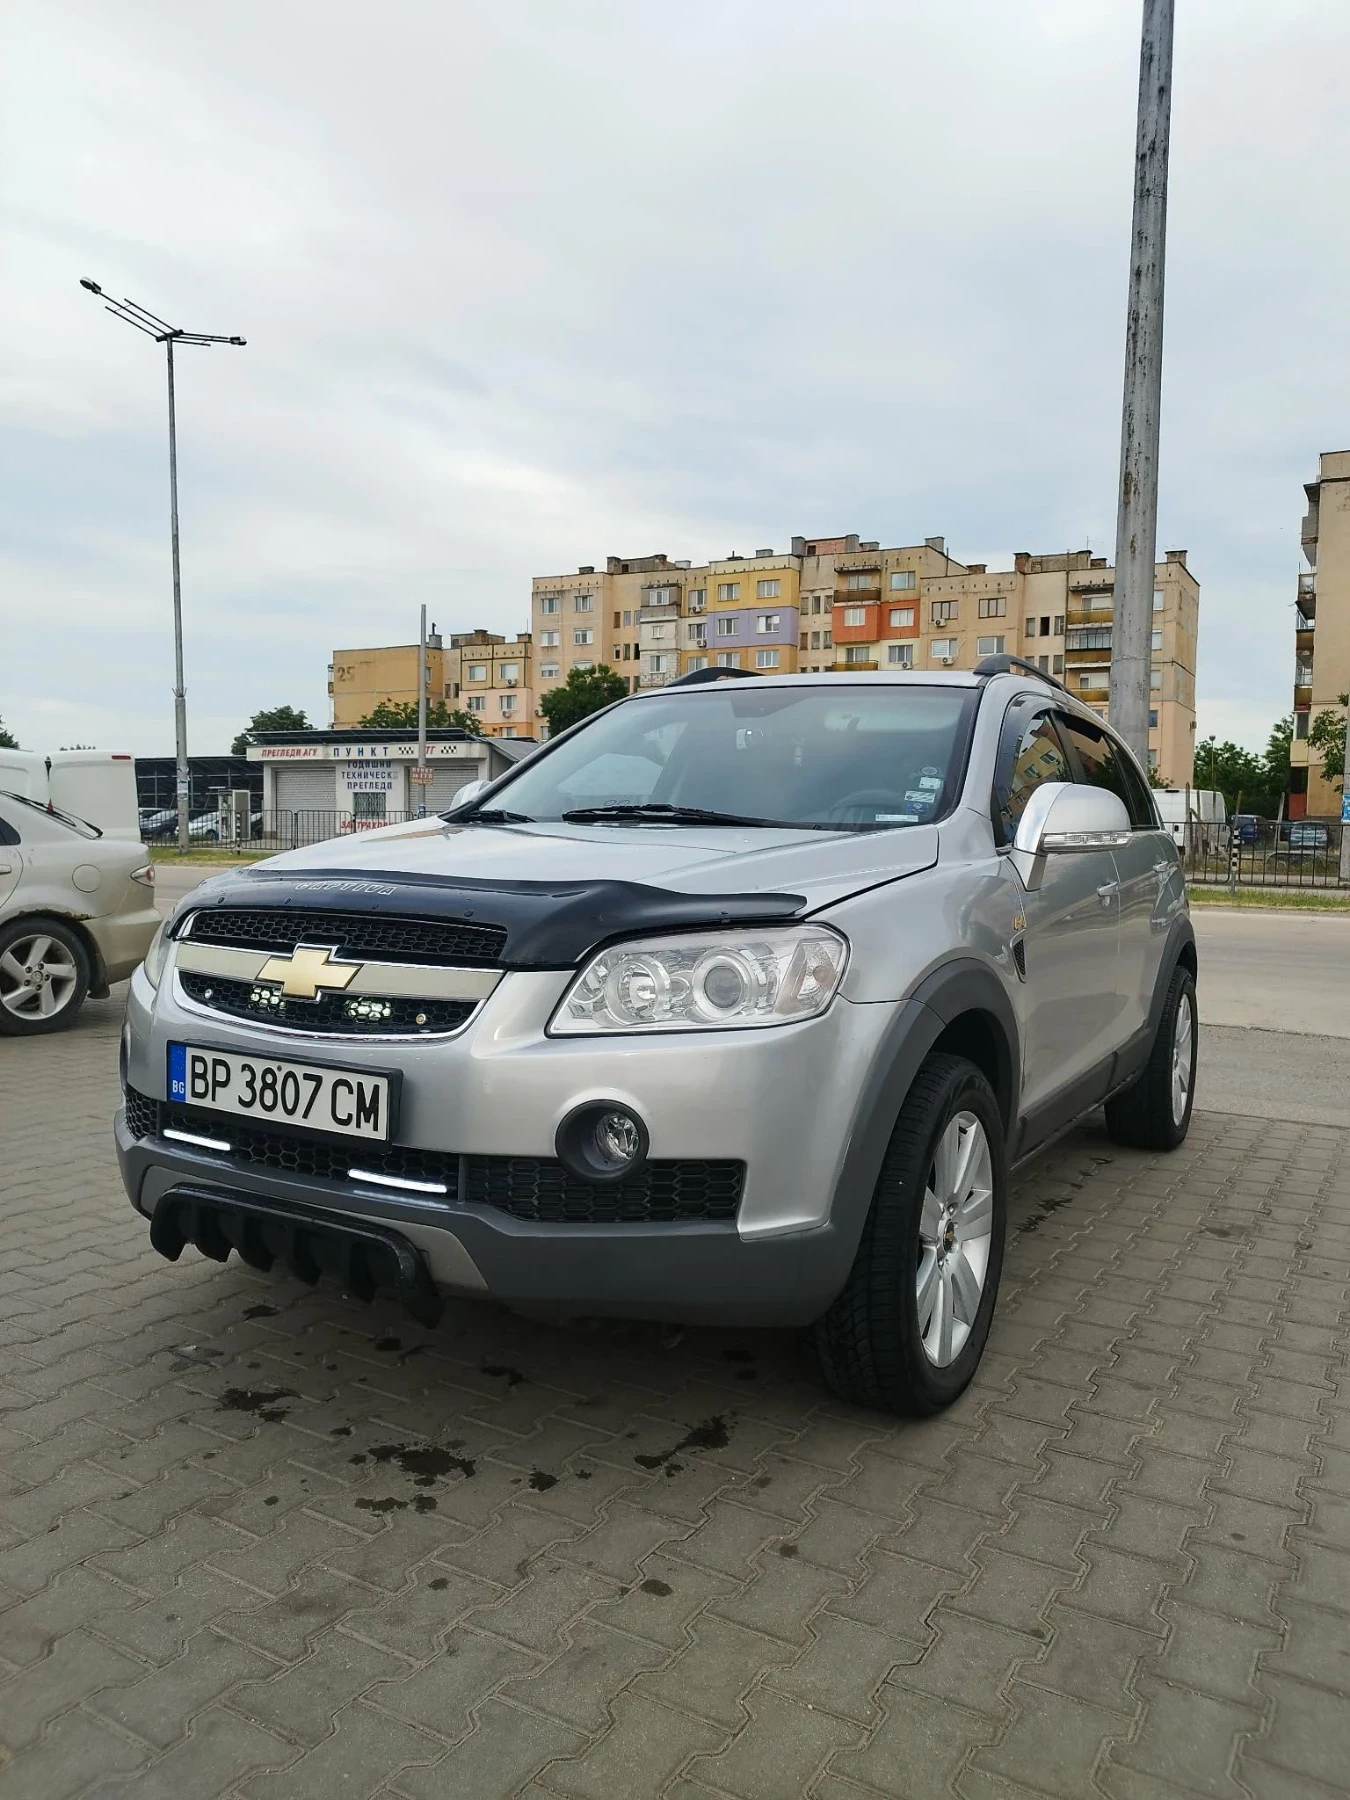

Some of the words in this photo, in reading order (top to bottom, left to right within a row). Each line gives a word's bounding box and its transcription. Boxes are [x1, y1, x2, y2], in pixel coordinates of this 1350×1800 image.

[261, 748, 301, 758] ПРЕГЛЕДИ
[333, 746, 389, 757] ПУНКТ
[341, 771, 398, 780] ТЕХНИЧЕСК
[295, 881, 398, 896] CAPTIVA
[172, 1079, 185, 1094] BG
[190, 1054, 231, 1102] BP
[237, 1063, 323, 1120] 3807
[330, 1078, 380, 1132] CM
